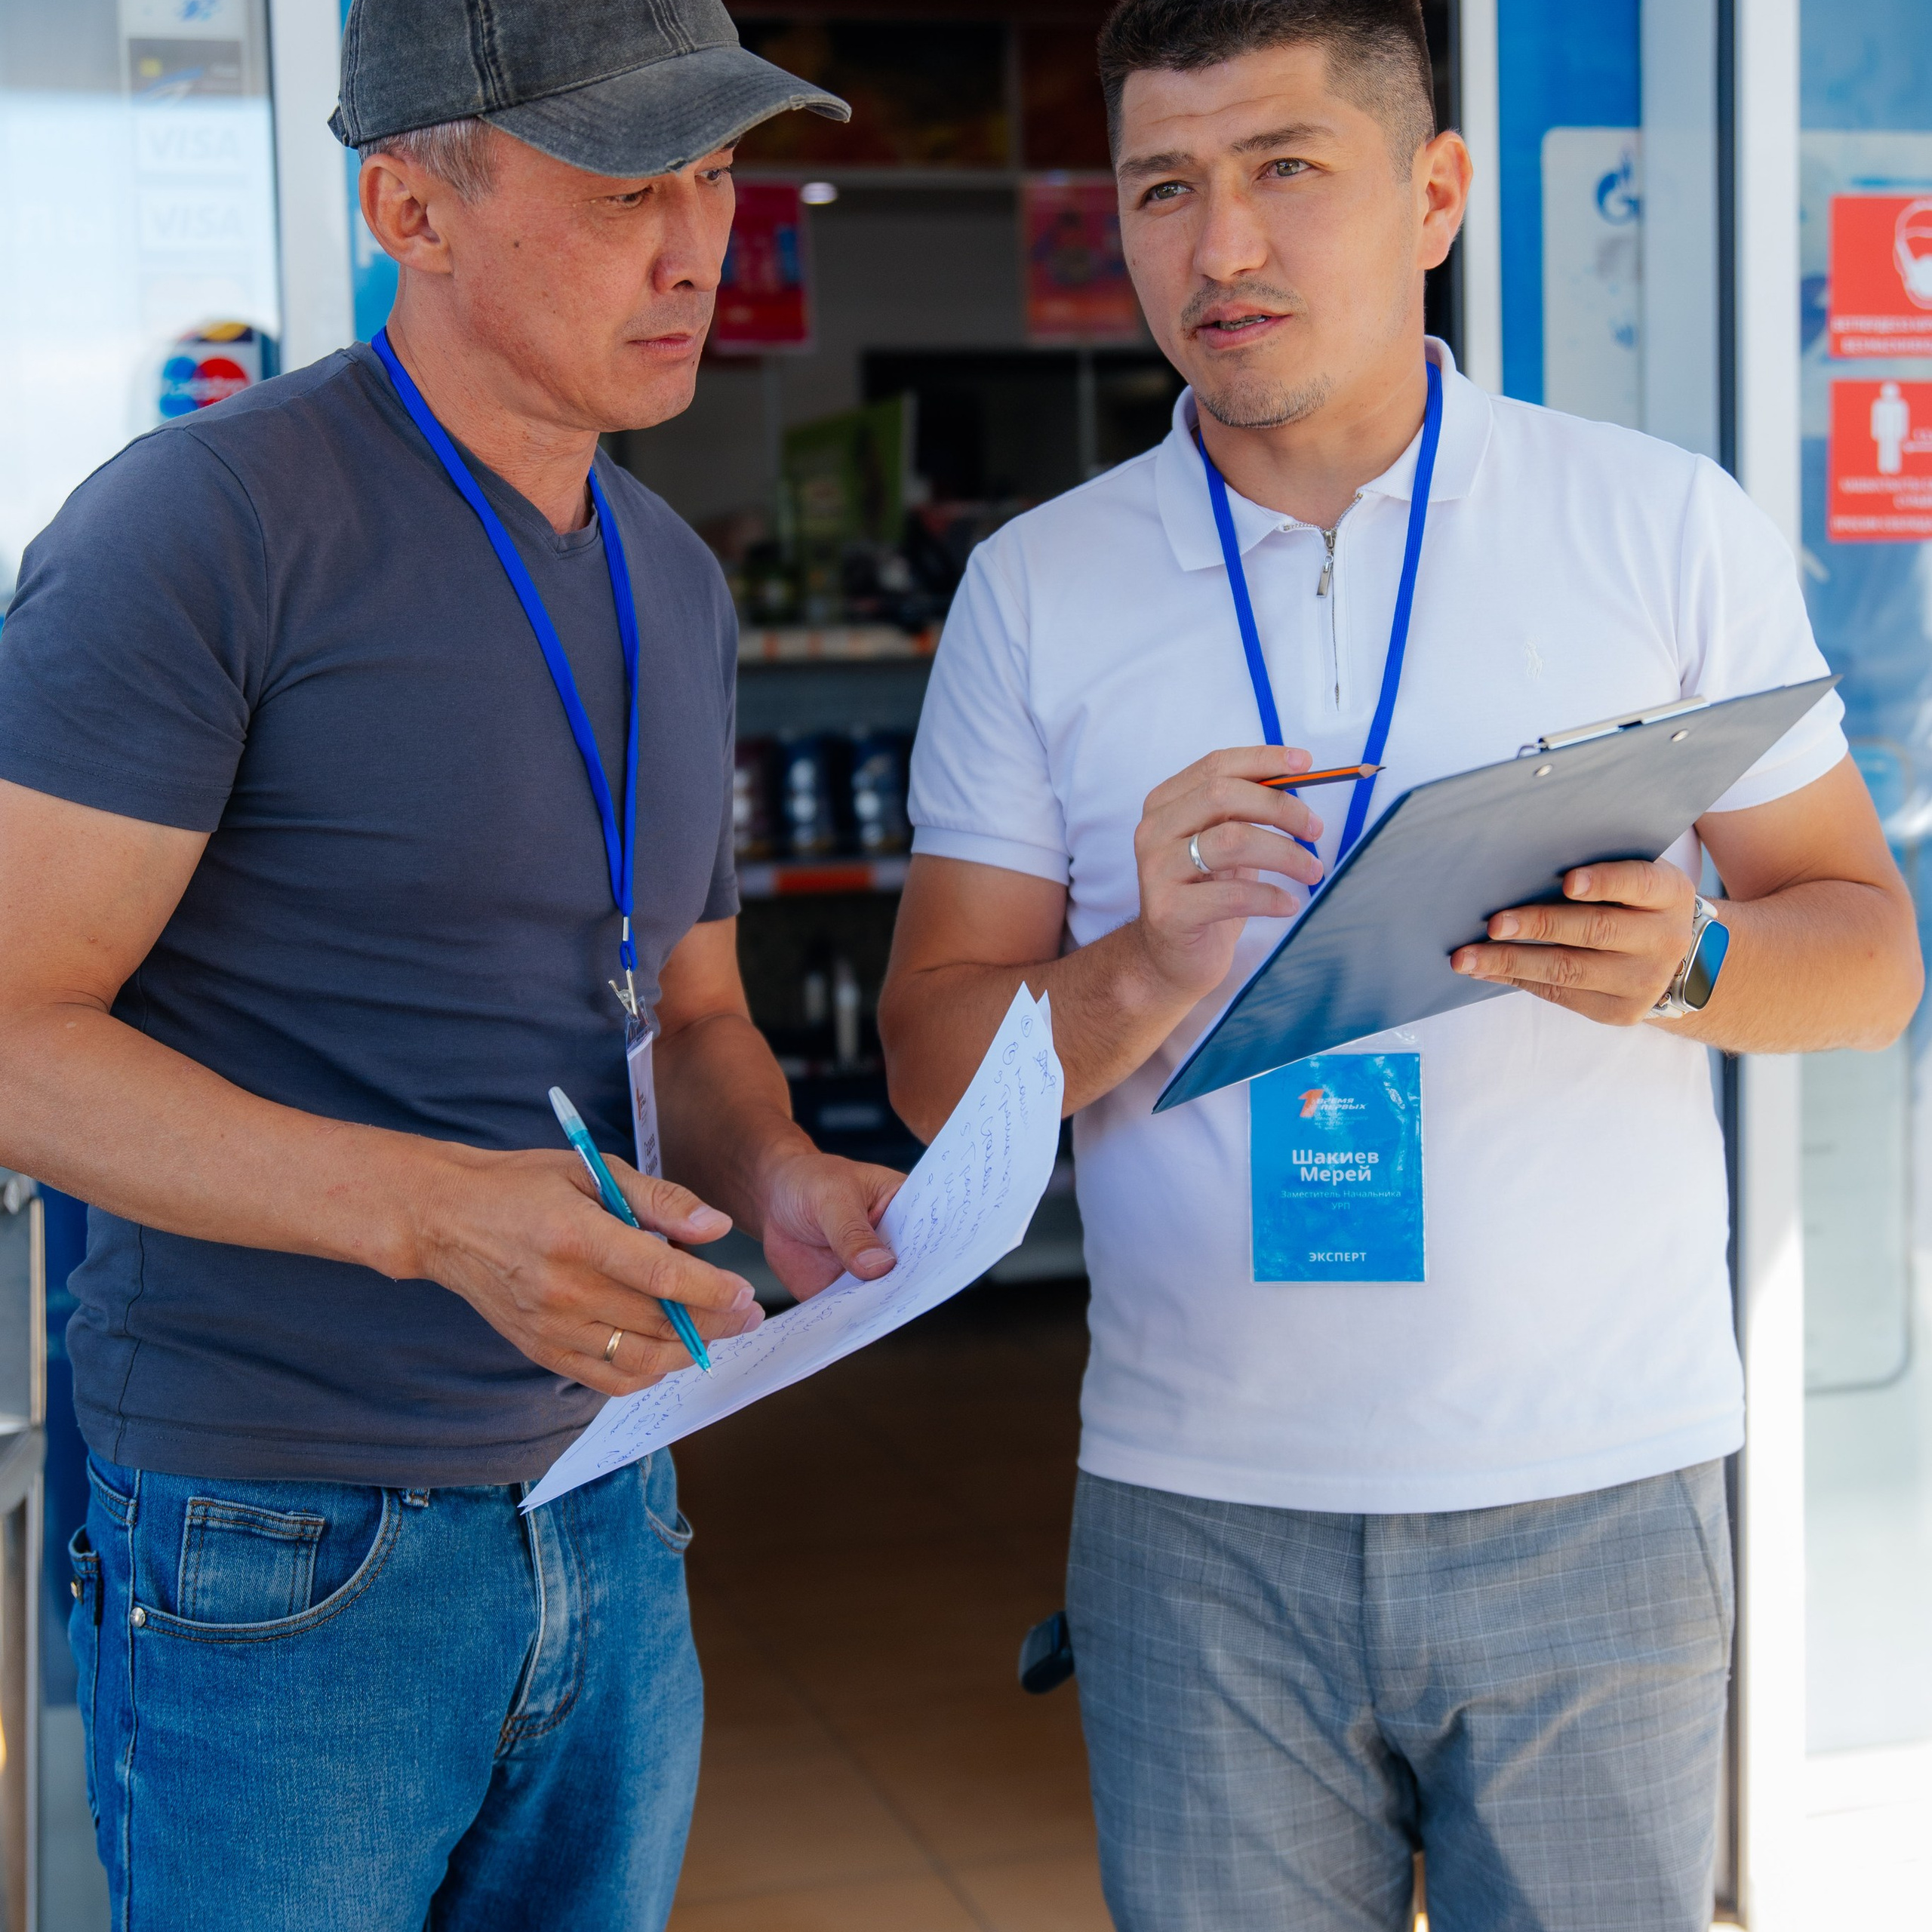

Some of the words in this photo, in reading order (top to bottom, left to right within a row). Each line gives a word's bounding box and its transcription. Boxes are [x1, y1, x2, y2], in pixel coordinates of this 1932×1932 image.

[149, 124, 242, 160] VISA
[149, 203, 245, 240] VISA
[1292, 1149, 1380, 1165] Шакиев
[1300, 1165, 1372, 1186] Мерей
[1281, 1190, 1340, 1198] Заместитель
[1343, 1189, 1401, 1198] Начальника
[1308, 1251, 1367, 1263] ЭКСПЕРТ
